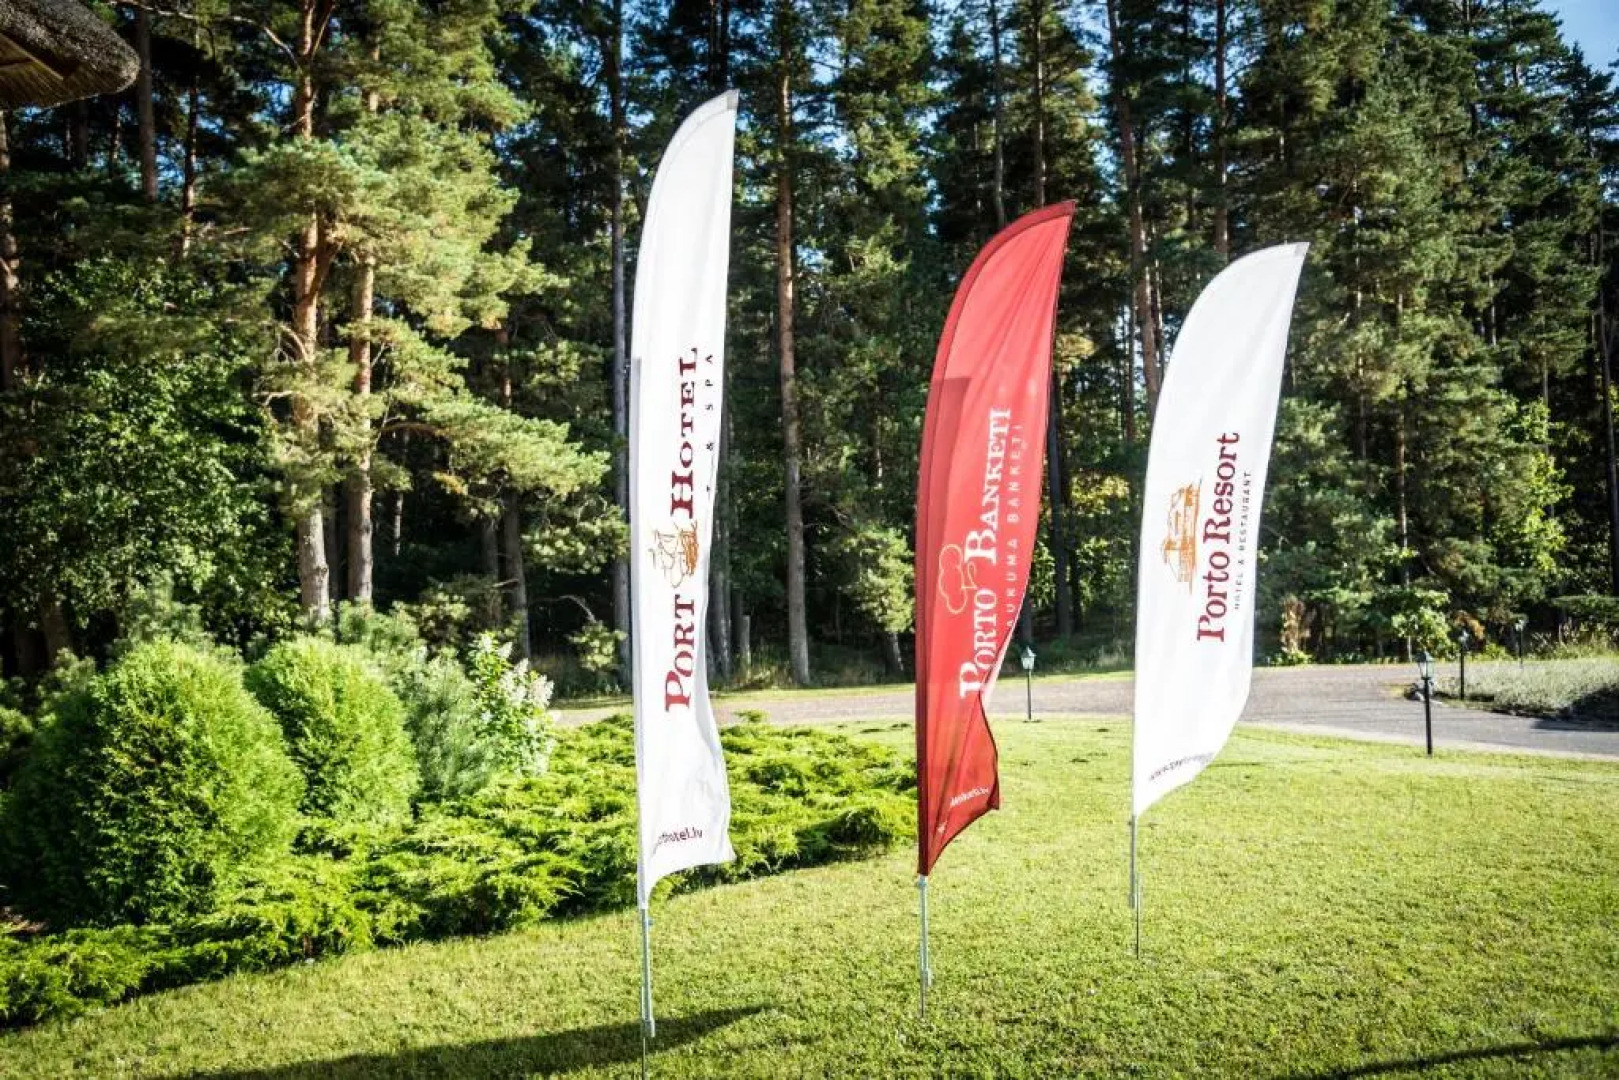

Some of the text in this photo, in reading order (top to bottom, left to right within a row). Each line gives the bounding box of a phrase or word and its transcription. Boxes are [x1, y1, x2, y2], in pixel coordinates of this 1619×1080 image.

[705, 354, 714, 451] & SPA
[664, 347, 698, 712] PORT HOTEL
[959, 407, 1011, 699] PORTO BANKETI
[1006, 424, 1023, 628] AUKUMA BANKETI
[1196, 432, 1240, 642] Porto Resort
[1238, 471, 1252, 551] RESTAURANT
